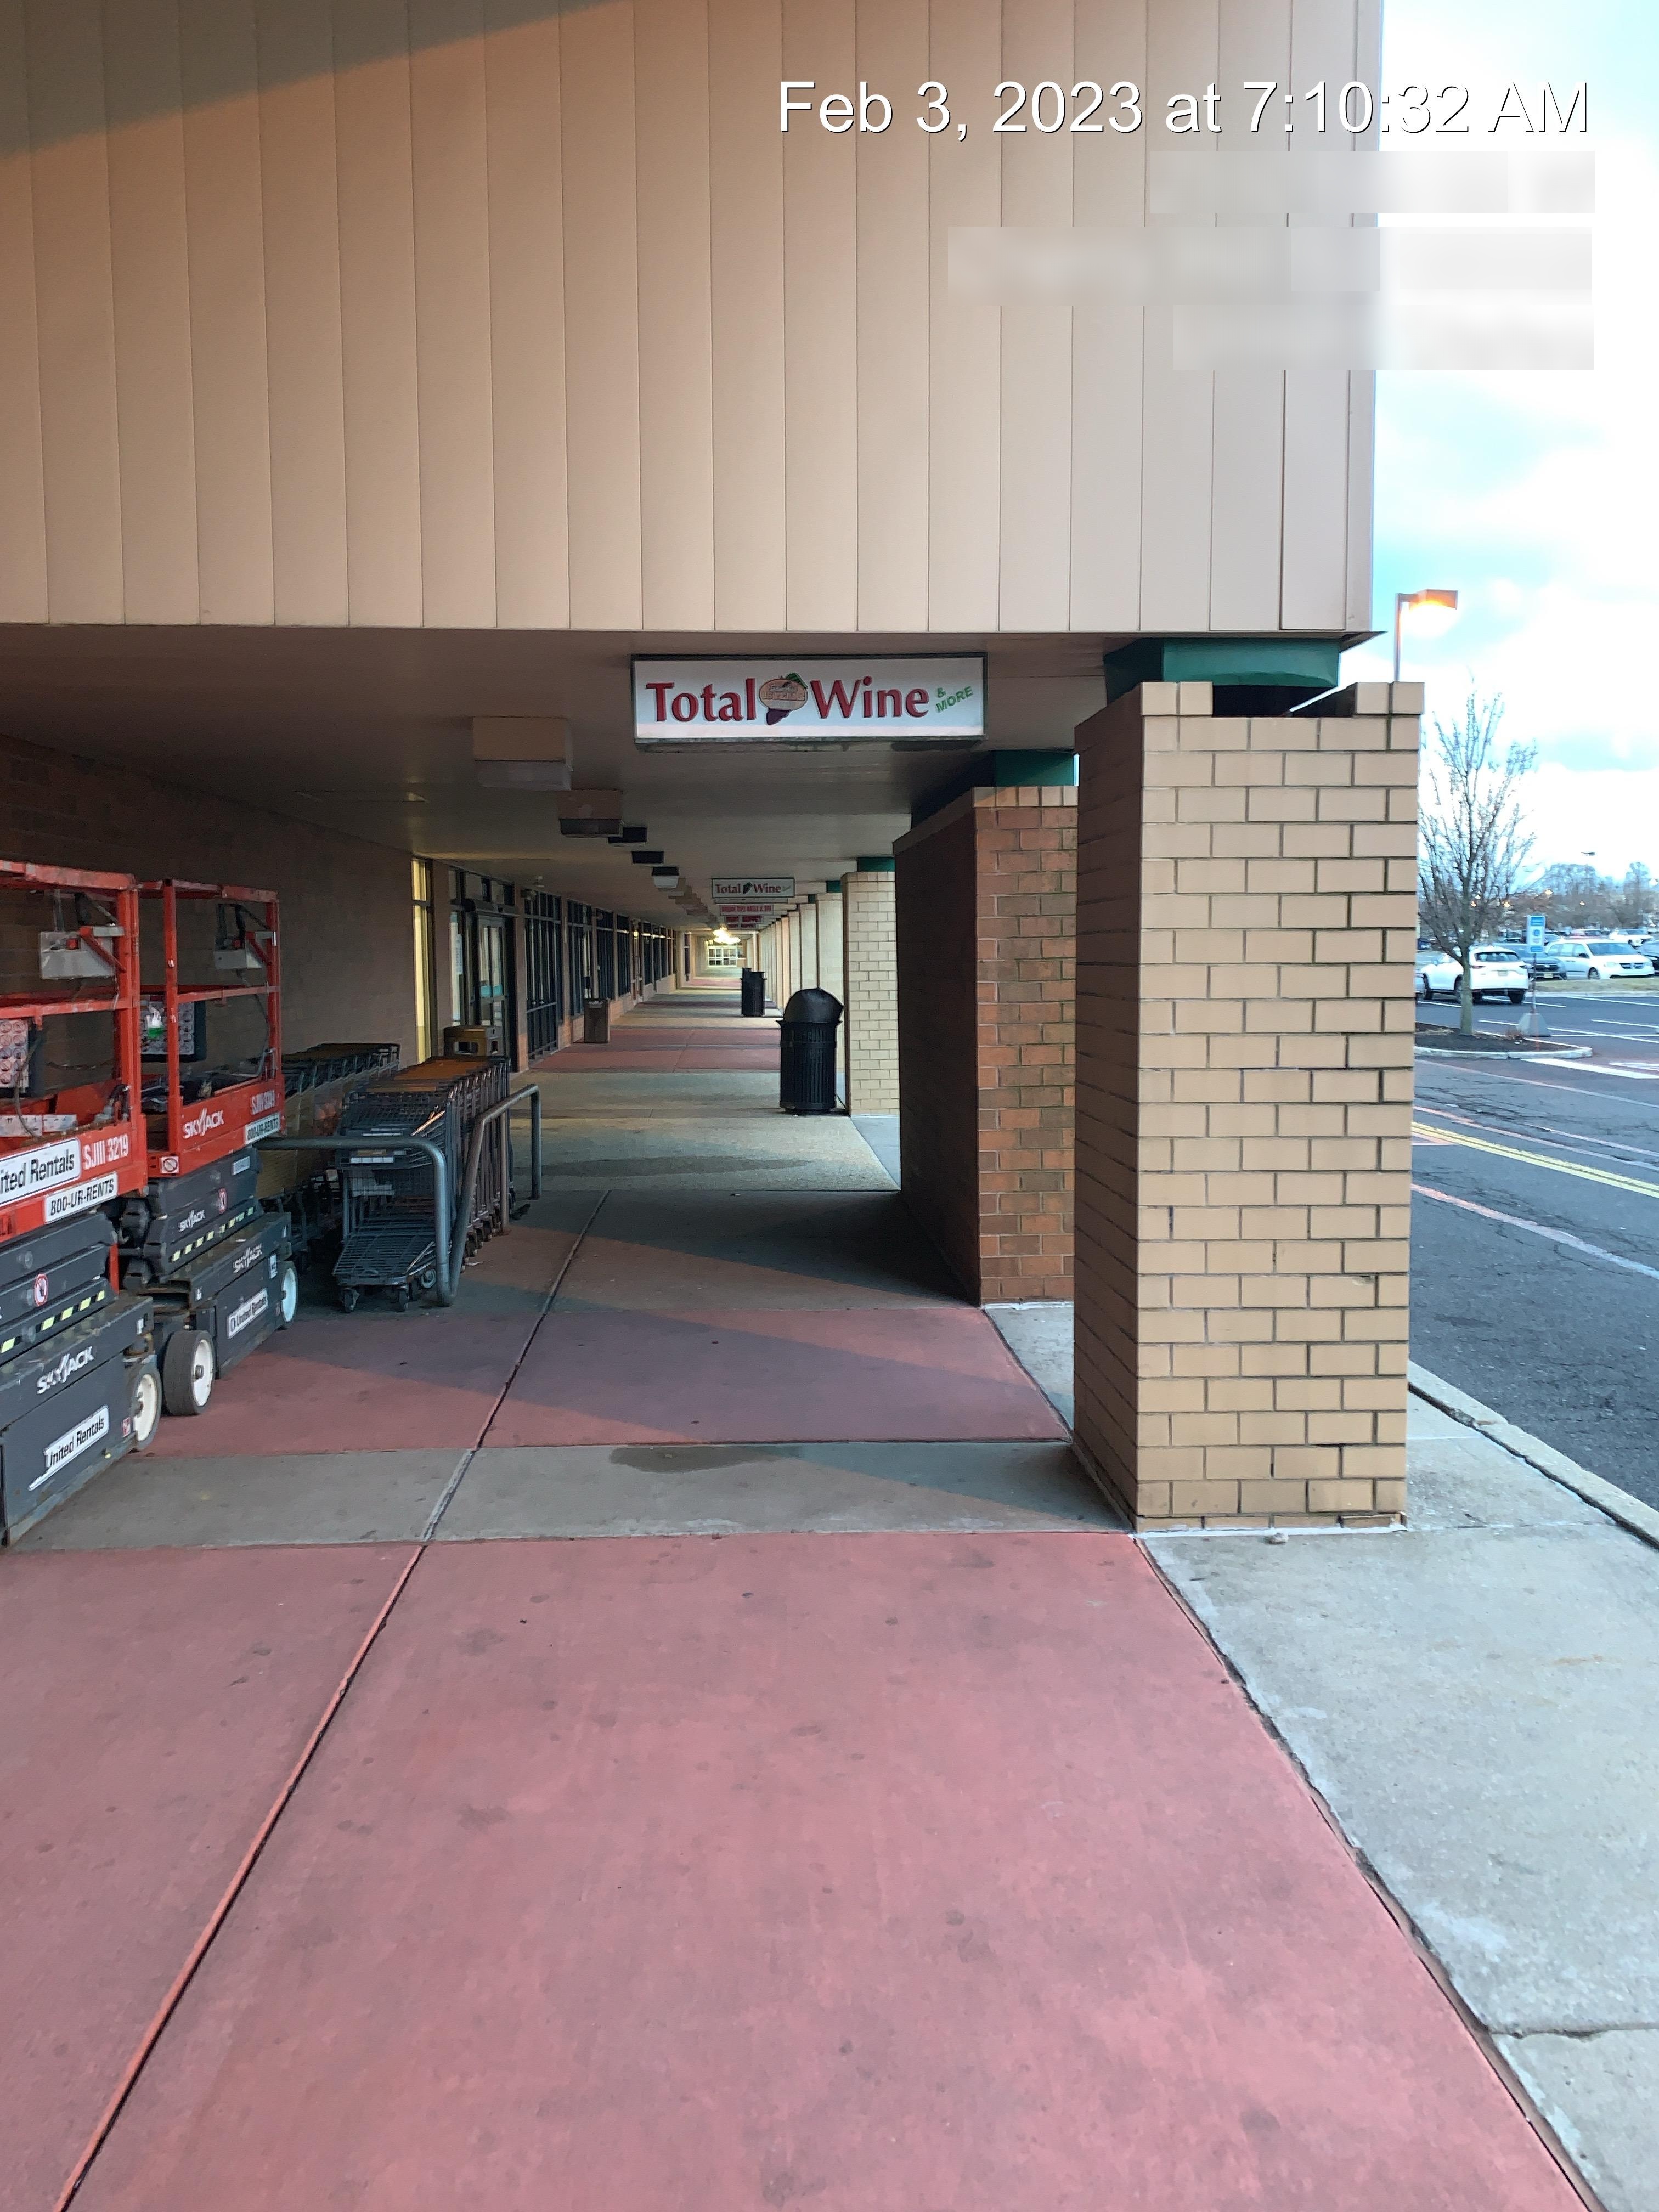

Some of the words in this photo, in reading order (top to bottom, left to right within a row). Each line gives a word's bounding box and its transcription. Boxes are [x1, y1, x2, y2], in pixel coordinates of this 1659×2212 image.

[646, 678, 757, 722] Total
[810, 675, 930, 719] Wine
[935, 686, 974, 713] MORE
[936, 687, 947, 698] &
[715, 883, 741, 894] Total
[753, 883, 782, 894] Wine
[183, 1106, 225, 1139] SKYJACK
[108, 1133, 129, 1163] 3219
[0, 1162, 26, 1194] ited
[30, 1149, 75, 1184] Rentals
[50, 1178, 114, 1216] 800-UR-RENTS
[76, 1415, 105, 1448] Rentals
